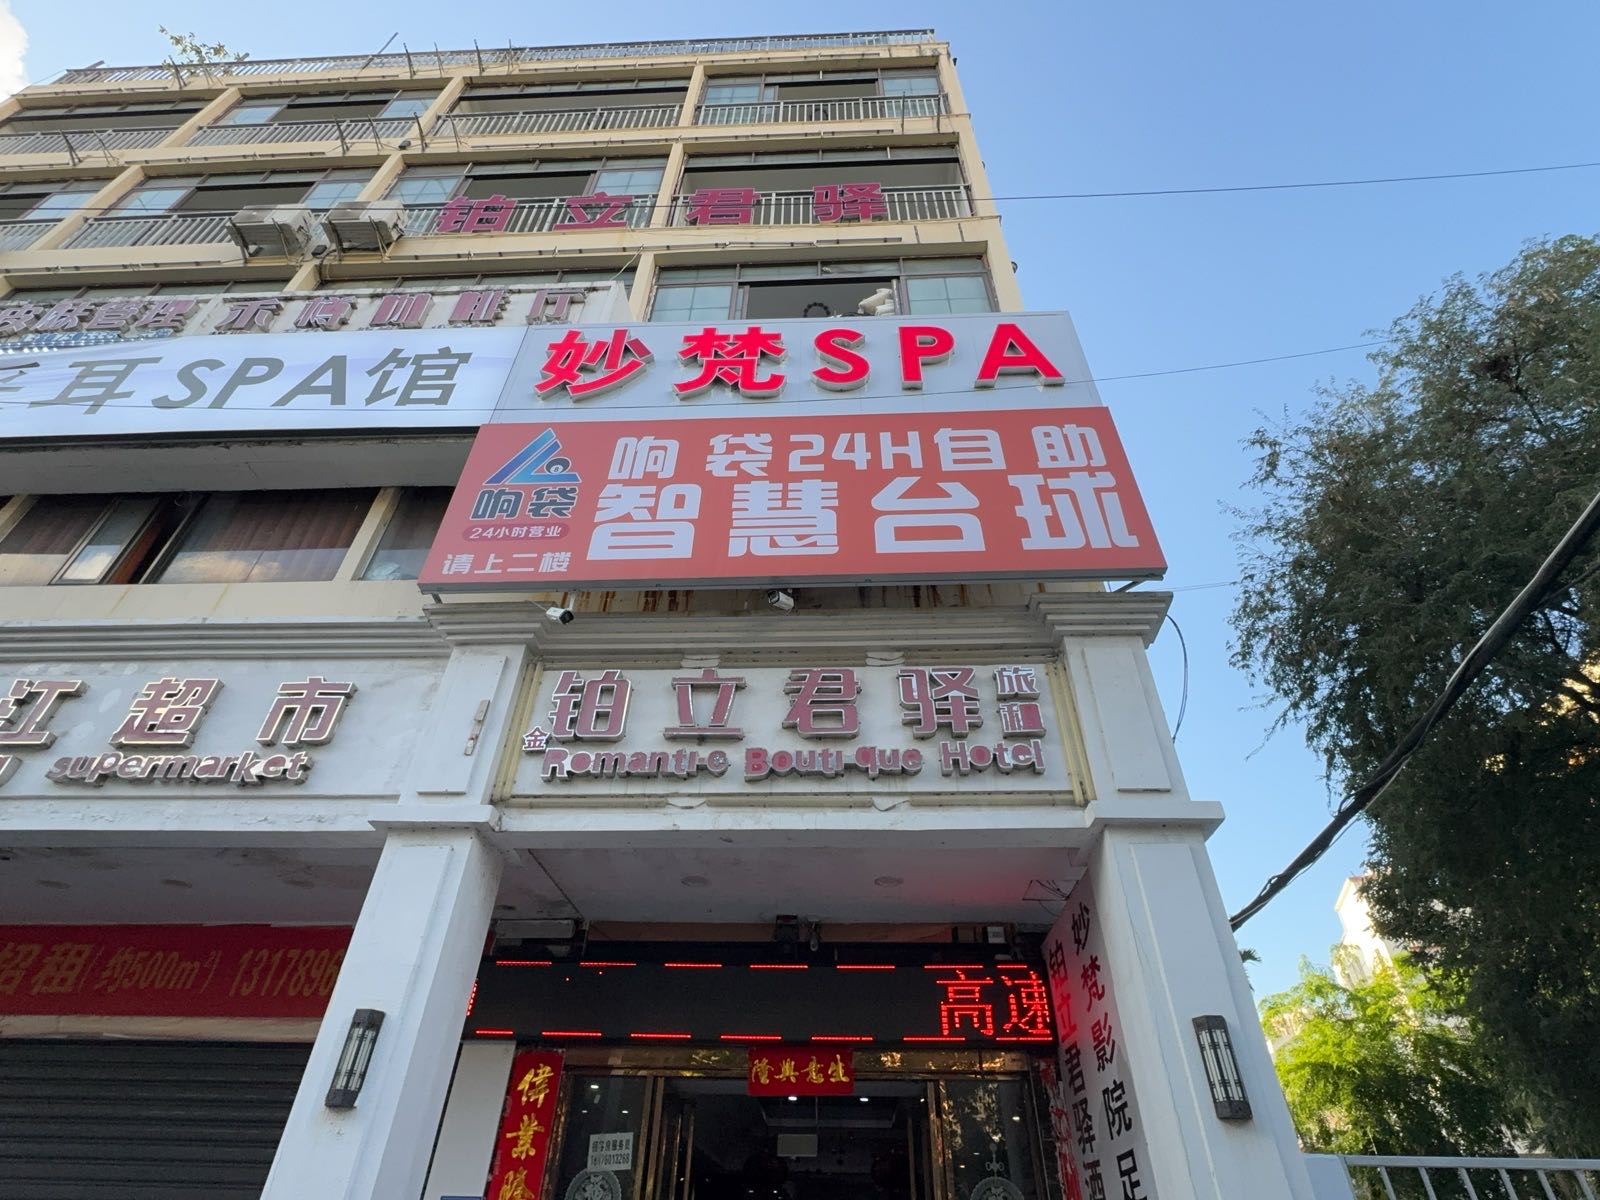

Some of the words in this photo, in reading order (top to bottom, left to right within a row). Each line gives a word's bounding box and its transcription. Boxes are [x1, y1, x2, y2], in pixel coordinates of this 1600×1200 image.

[434, 181, 888, 234] 铂立君驿
[534, 323, 1065, 400] 妙梵SPA
[608, 423, 1107, 482] 响袋24H自助
[469, 486, 579, 520] 响袋
[586, 471, 1140, 561] 智慧台球
[469, 525, 562, 540] 24小时营业
[442, 551, 572, 575] 请上二楼
[548, 667, 983, 741] 铂立君驿
[48, 751, 312, 786] supermarket
[940, 738, 1046, 776] Hotel
